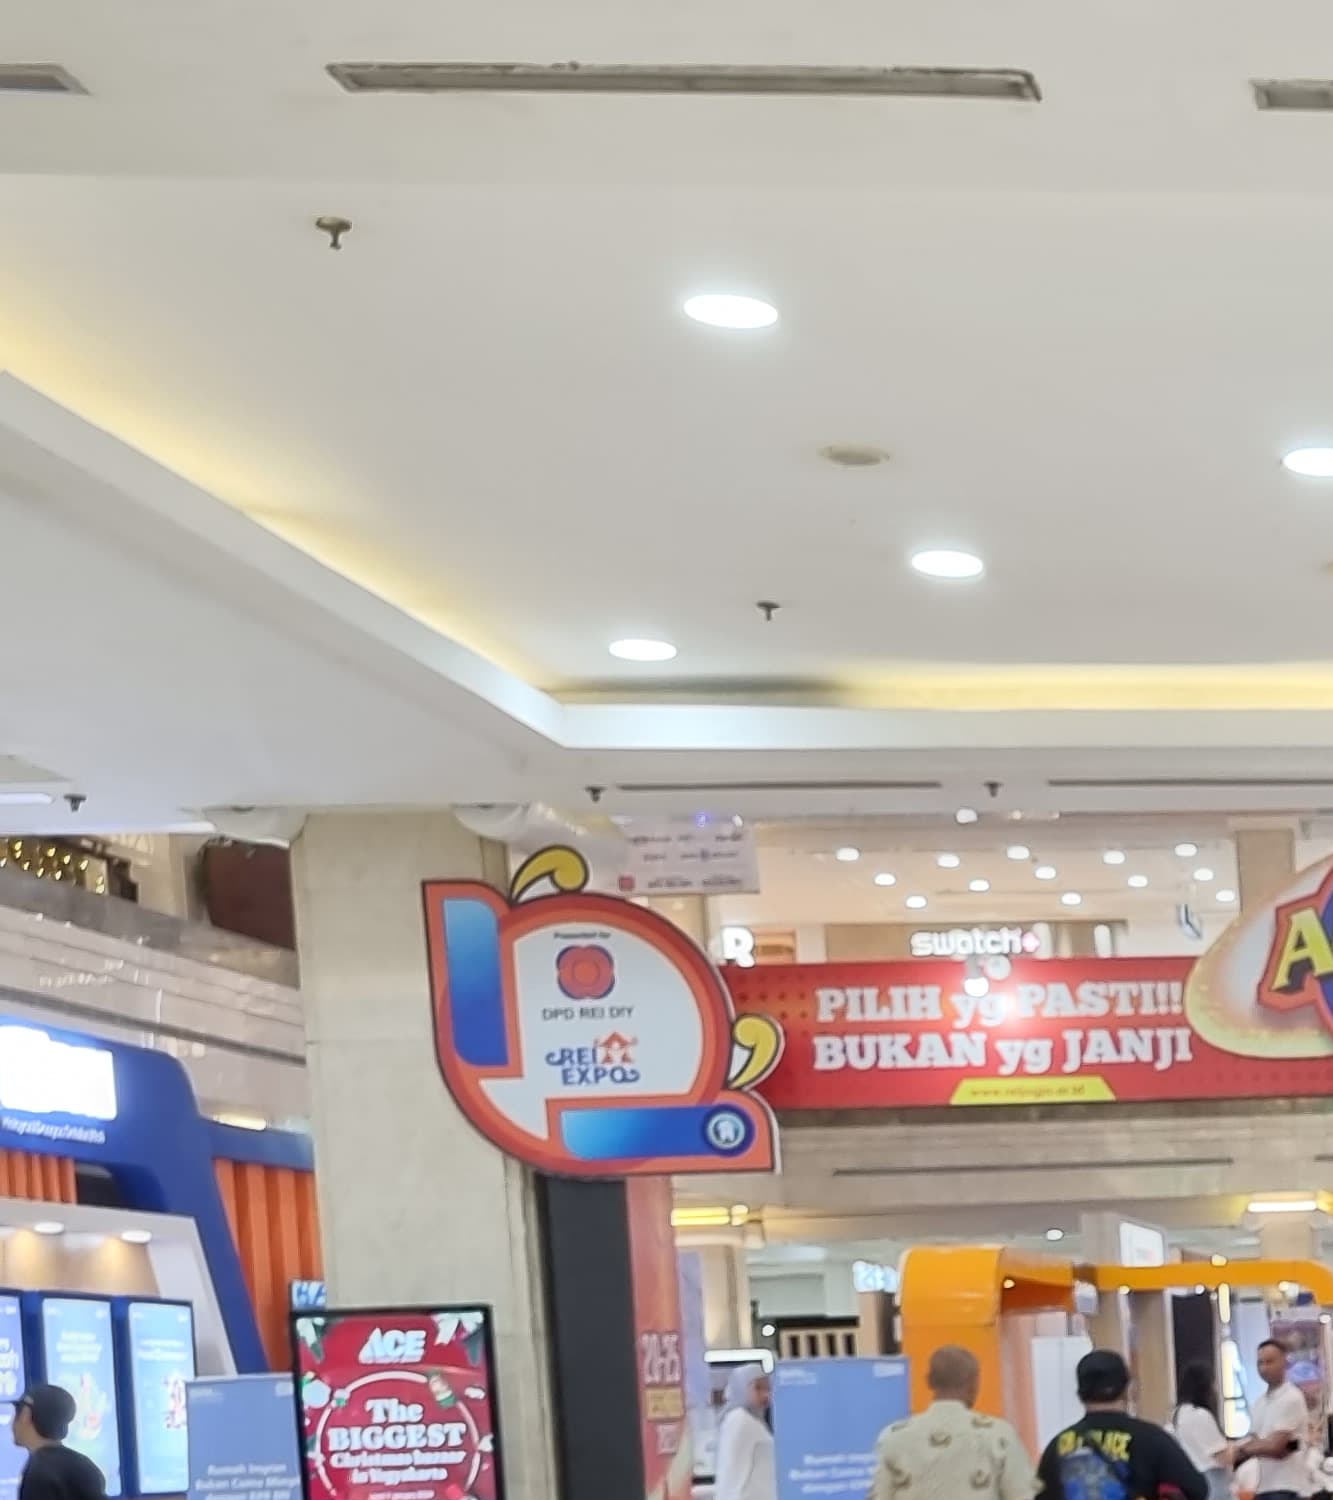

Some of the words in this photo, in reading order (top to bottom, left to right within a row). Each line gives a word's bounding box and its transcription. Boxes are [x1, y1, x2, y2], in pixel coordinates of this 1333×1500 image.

[579, 1006, 605, 1020] REI
[816, 985, 941, 1022] PILIH
[951, 991, 1009, 1028] yg
[1017, 981, 1183, 1019] PASTI!!
[546, 1047, 598, 1066] REI
[813, 1032, 987, 1071] BUKAN
[995, 1038, 1052, 1075] yg
[1062, 1028, 1193, 1073] JANJI
[561, 1066, 640, 1086] EXPO
[358, 1328, 426, 1361] ACE
[365, 1398, 424, 1423] The
[327, 1423, 467, 1452] BIGGEST
